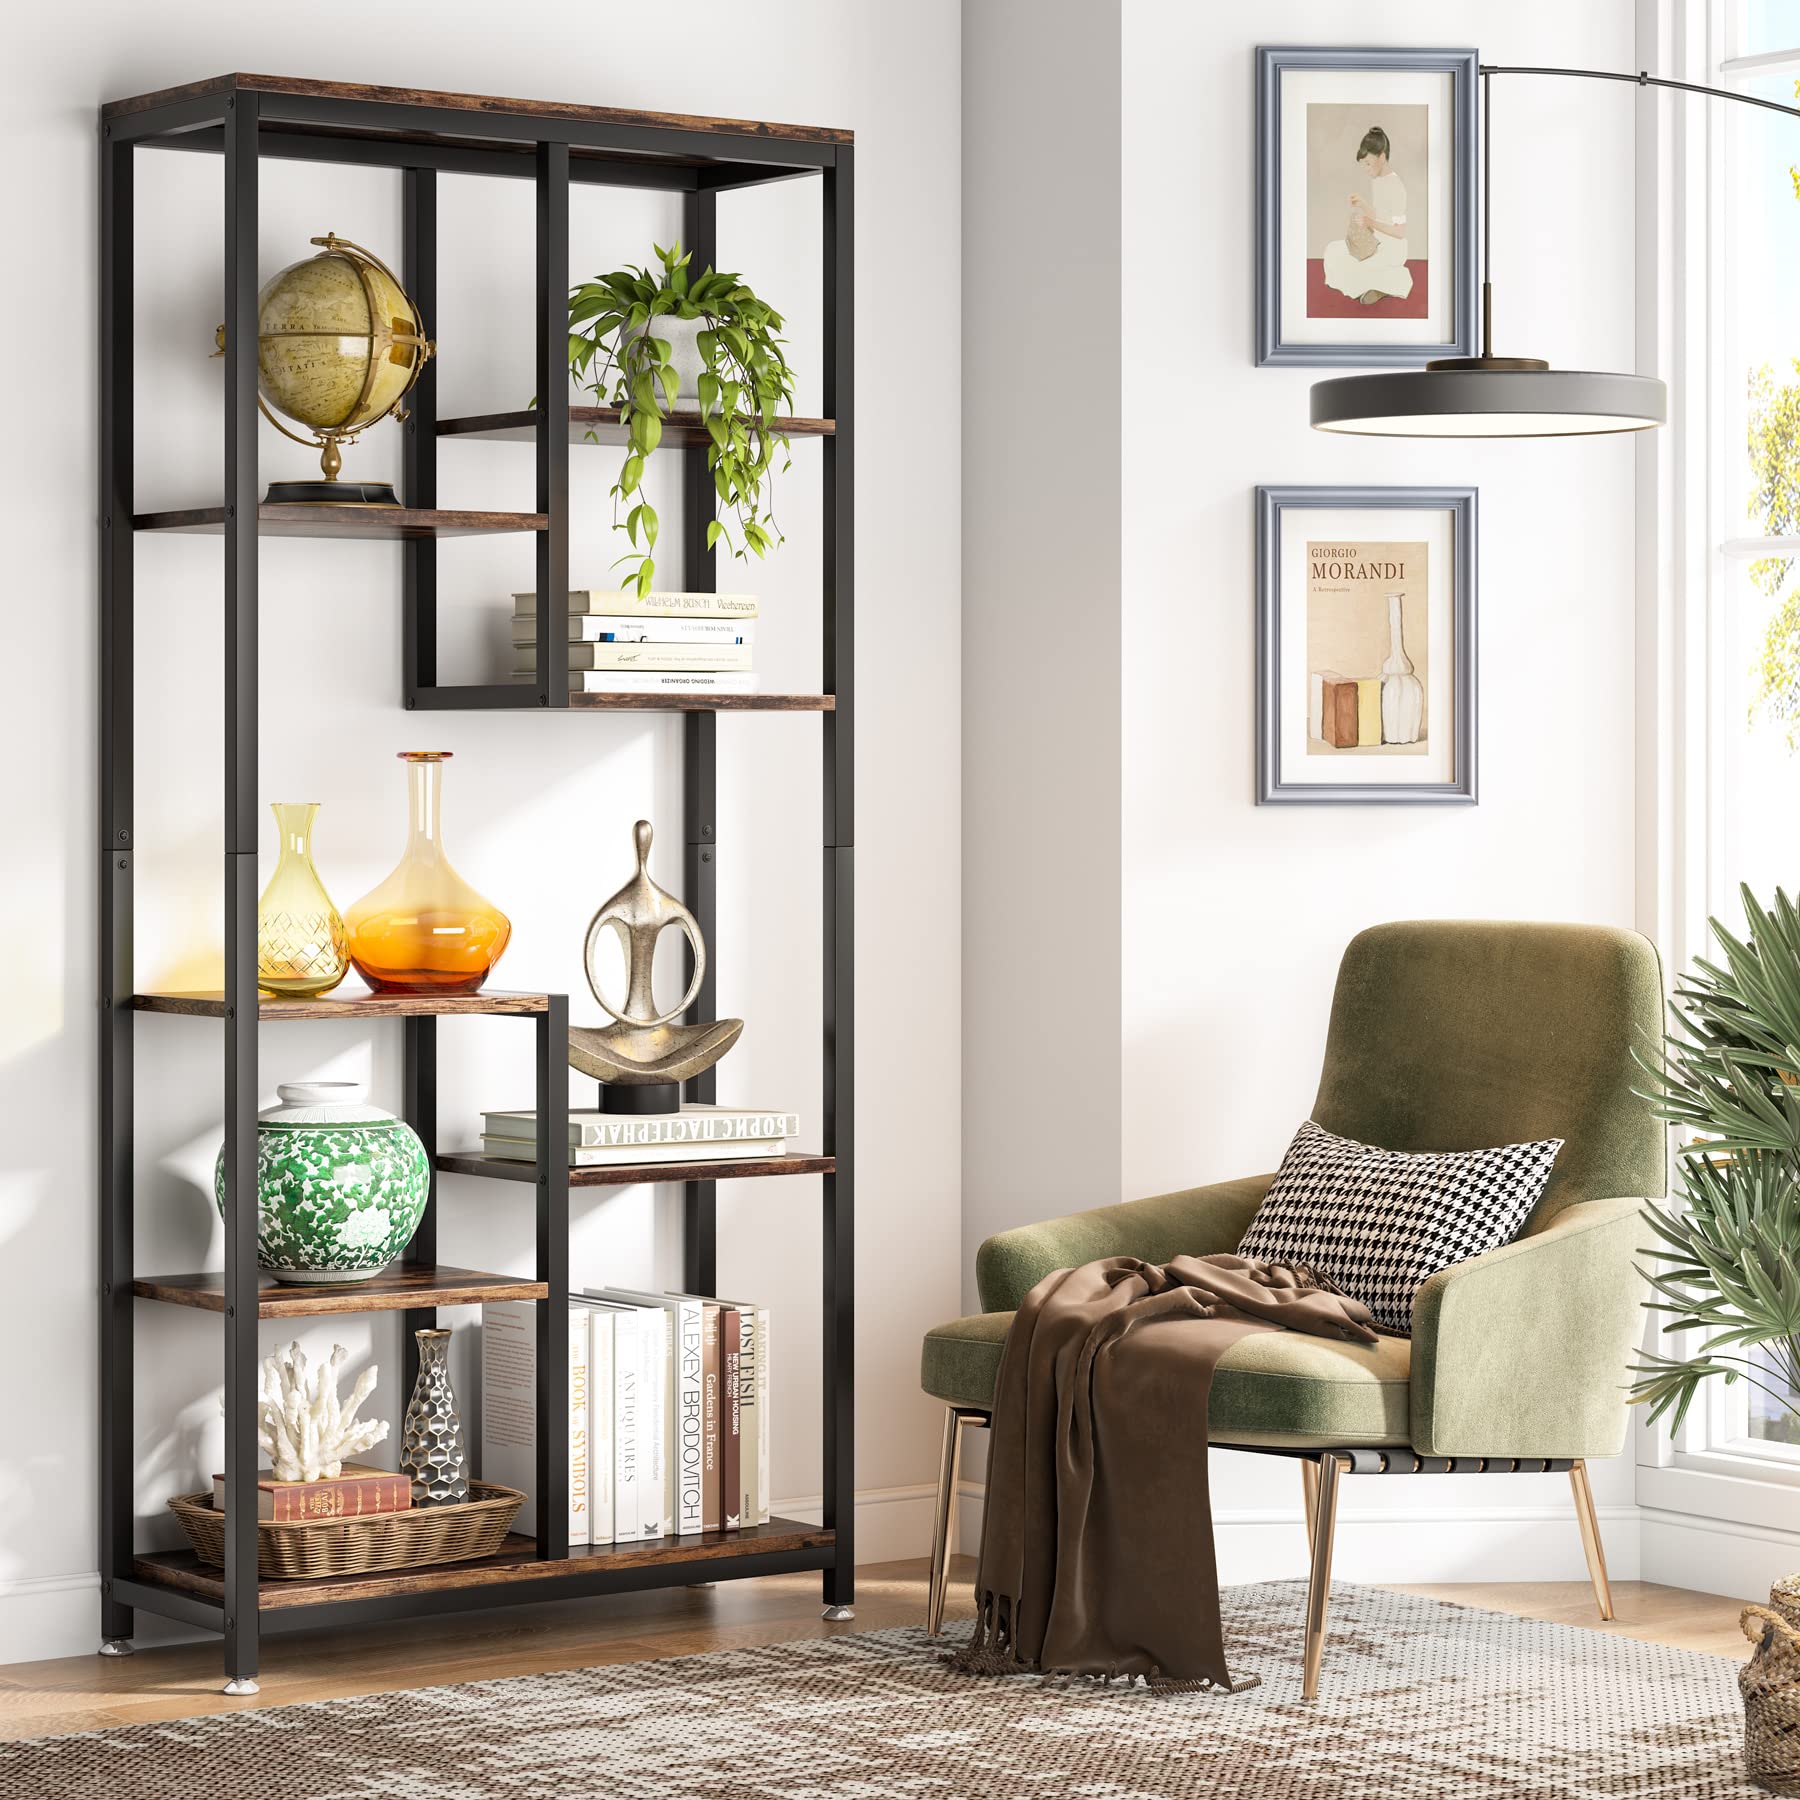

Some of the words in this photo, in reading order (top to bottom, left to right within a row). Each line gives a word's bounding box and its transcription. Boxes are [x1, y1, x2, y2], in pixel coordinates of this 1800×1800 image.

[1311, 548, 1357, 559] GIORGIO
[1311, 562, 1405, 580] MORANDI
[592, 1119, 715, 1145] ПАСТЕРНАК
[722, 1116, 787, 1138] БОРИС
[683, 1308, 700, 1384] ALEXEY
[740, 1312, 754, 1360] LOST
[572, 1364, 586, 1412] BOOK
[706, 1373, 717, 1418] Gardens
[740, 1365, 754, 1406] FISH
[623, 1370, 636, 1482] ANTIQUAIRES
[706, 1420, 716, 1431] in
[732, 1399, 740, 1435] HOUSING
[572, 1430, 586, 1513] SYMBOLS
[683, 1390, 700, 1519] BRODOVITCH
[706, 1434, 716, 1471] France
